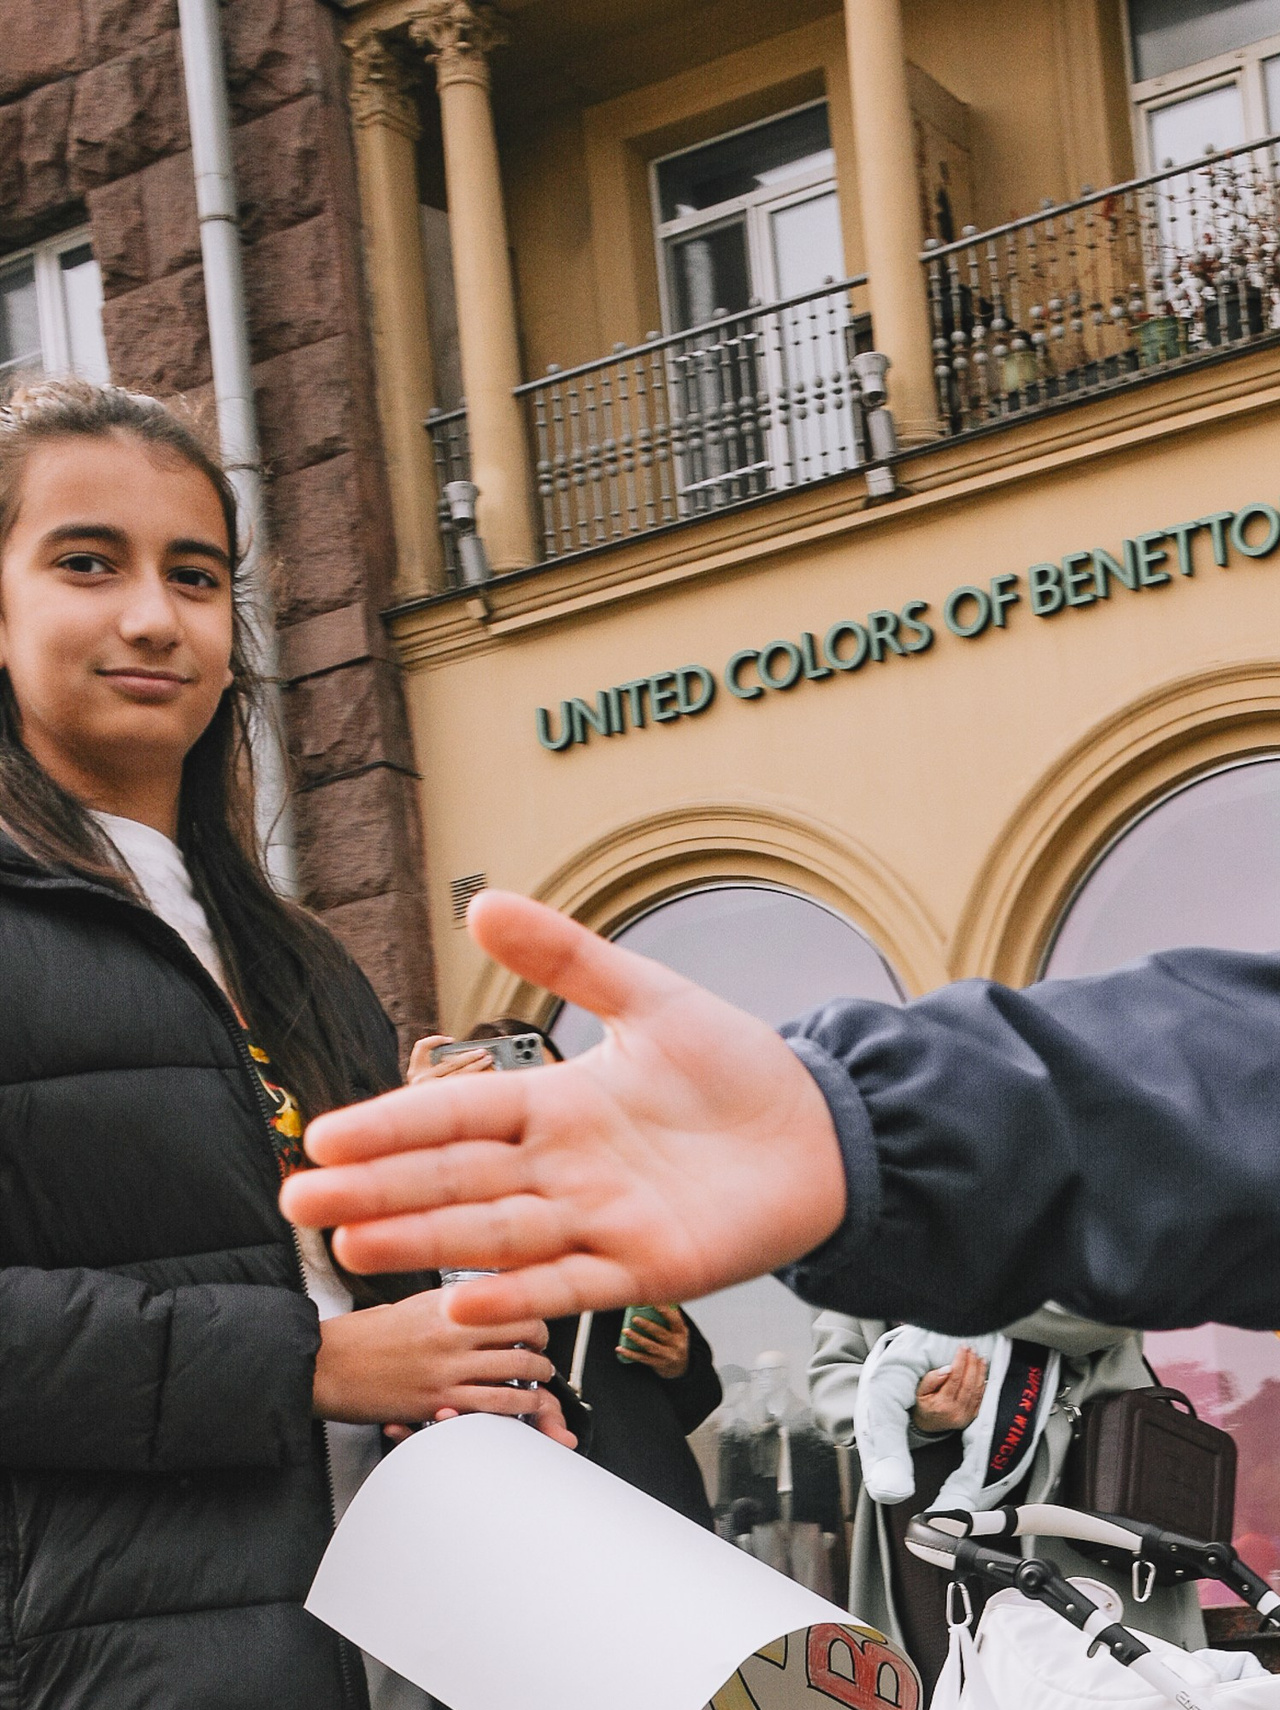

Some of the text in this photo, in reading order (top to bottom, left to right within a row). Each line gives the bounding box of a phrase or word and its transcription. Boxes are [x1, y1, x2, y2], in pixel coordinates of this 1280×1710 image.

[535, 663, 716, 751] UNITED
[724, 600, 933, 701] COLORS
[943, 574, 1020, 640] OF
[1019, 1366, 1042, 1413] SUPER
